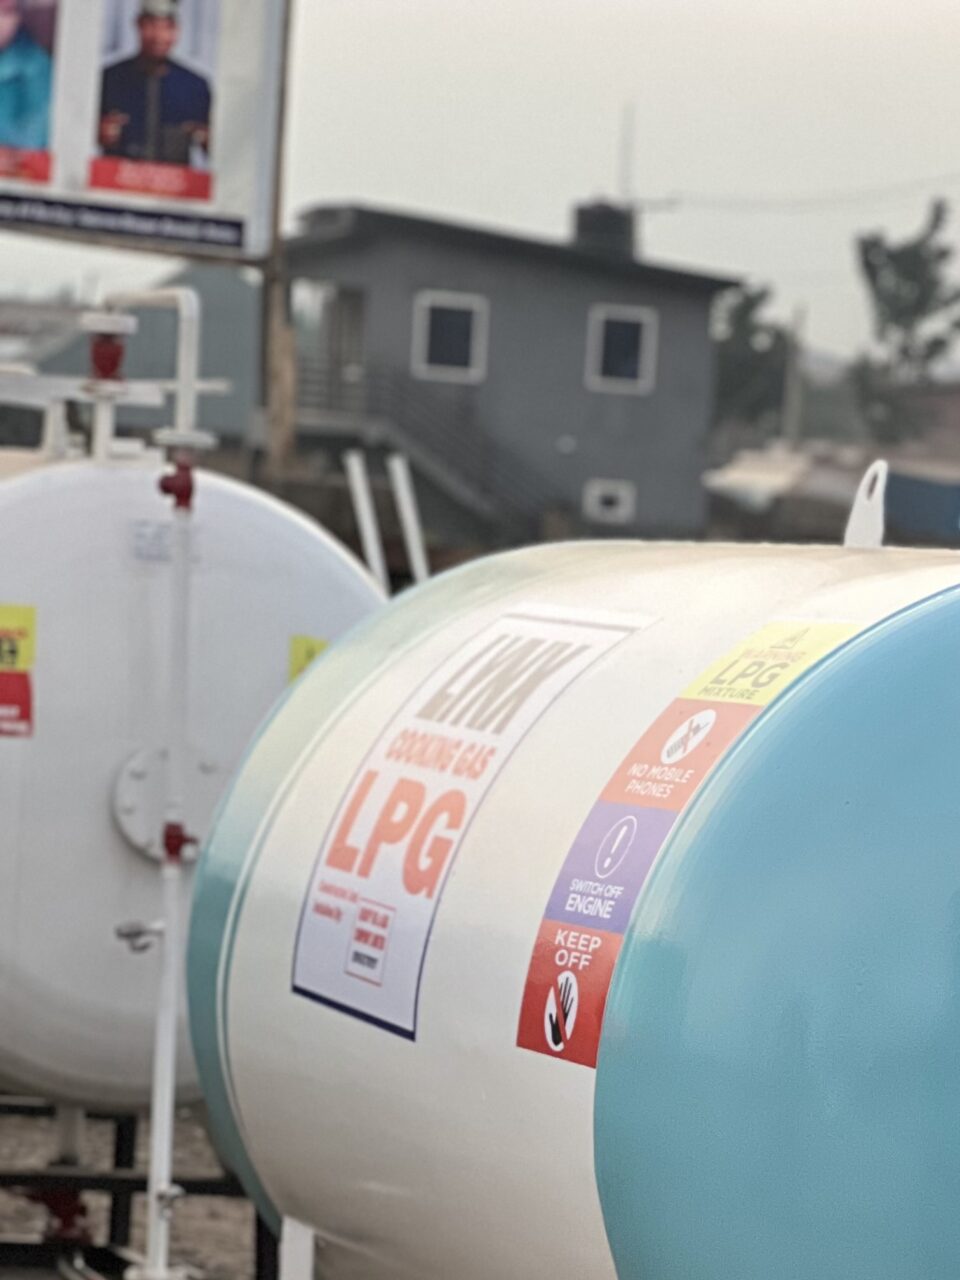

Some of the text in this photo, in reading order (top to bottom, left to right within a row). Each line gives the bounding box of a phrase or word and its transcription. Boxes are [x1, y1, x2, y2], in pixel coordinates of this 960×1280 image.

[415, 633, 592, 735] LYNX
[709, 657, 790, 689] LPG
[698, 685, 759, 700] MIXTURE
[386, 728, 497, 780] COOKING GAS
[627, 762, 694, 784] NO MOBILE
[624, 779, 674, 798] PHONES
[324, 768, 468, 900] LPG
[568, 878, 624, 898] SWITCH OFF
[565, 893, 615, 918] ENGINE
[555, 928, 602, 951] KEEP
[554, 949, 593, 970] OFF
